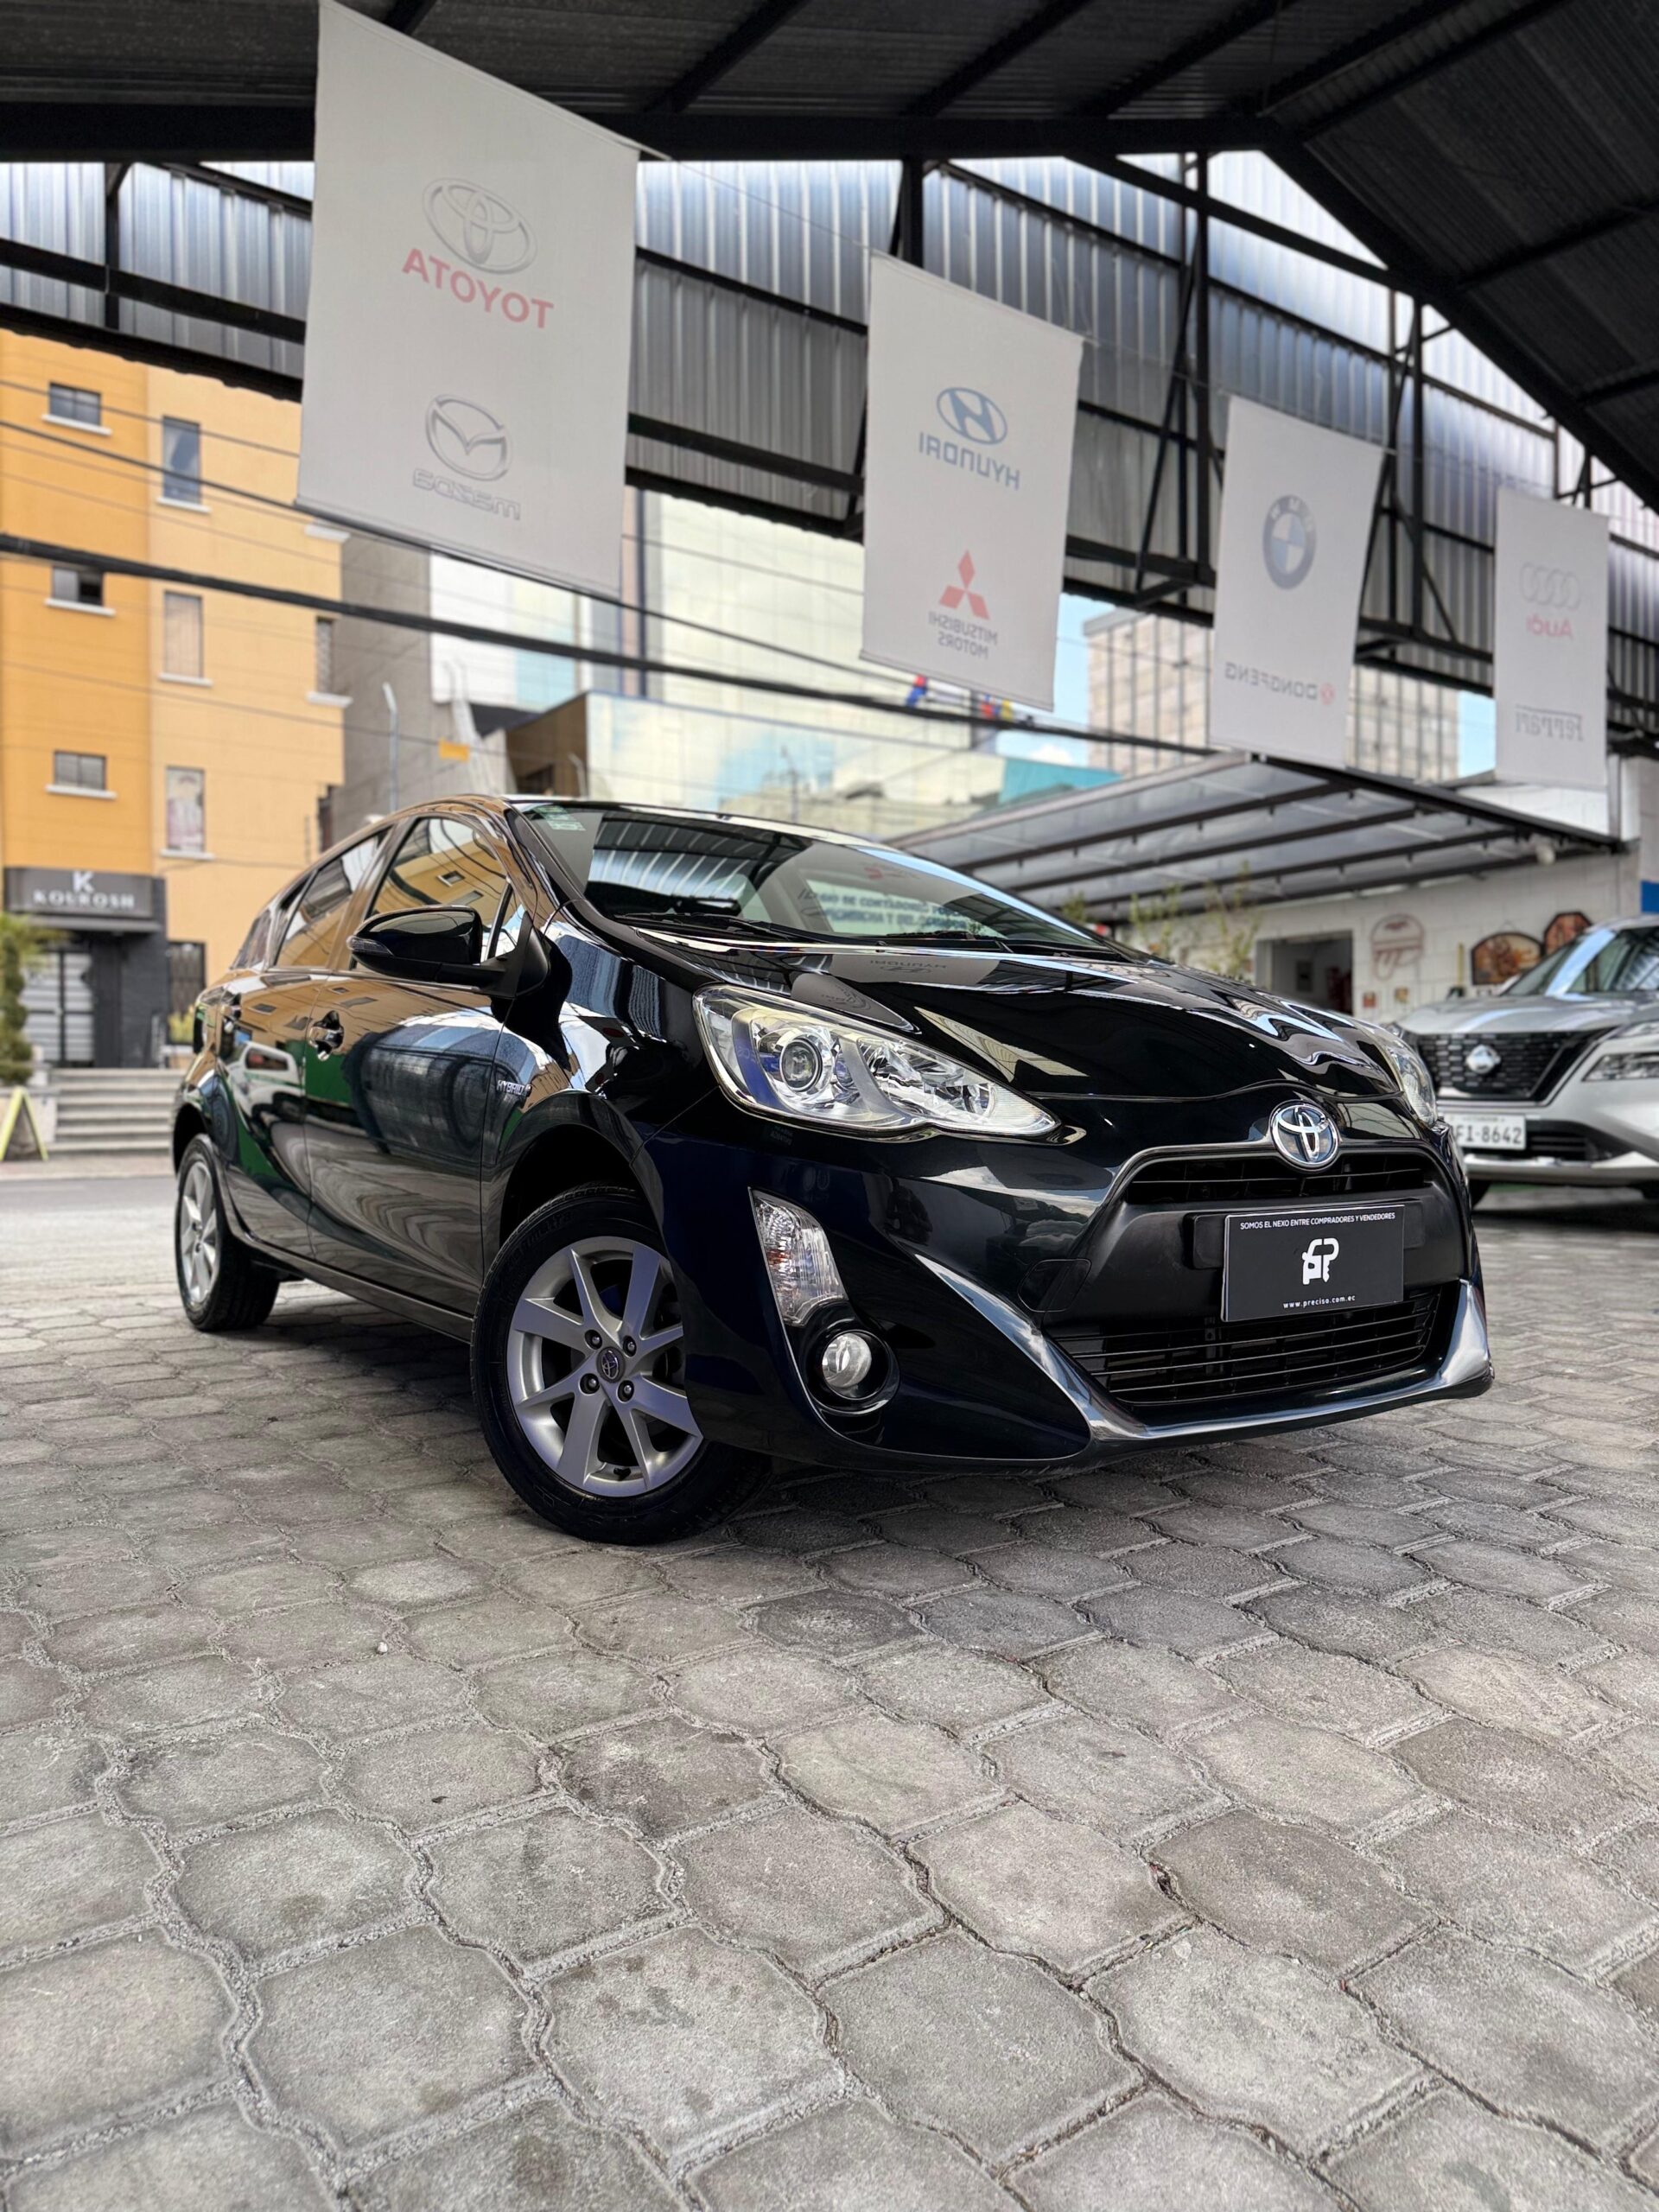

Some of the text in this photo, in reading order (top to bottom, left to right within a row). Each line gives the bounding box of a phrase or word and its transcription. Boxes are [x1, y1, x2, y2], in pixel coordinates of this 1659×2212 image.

[497, 1079, 525, 1096] HYBRID
[1240, 1221, 1263, 1230] SOMOS
[1273, 1219, 1290, 1228] NEXO
[1290, 1218, 1310, 1227] ENTRE
[1310, 1215, 1355, 1225] COMPRADORES
[1359, 1212, 1395, 1222] VENDEDORES
[1283, 1295, 1356, 1308] www.preciso.com.ec
